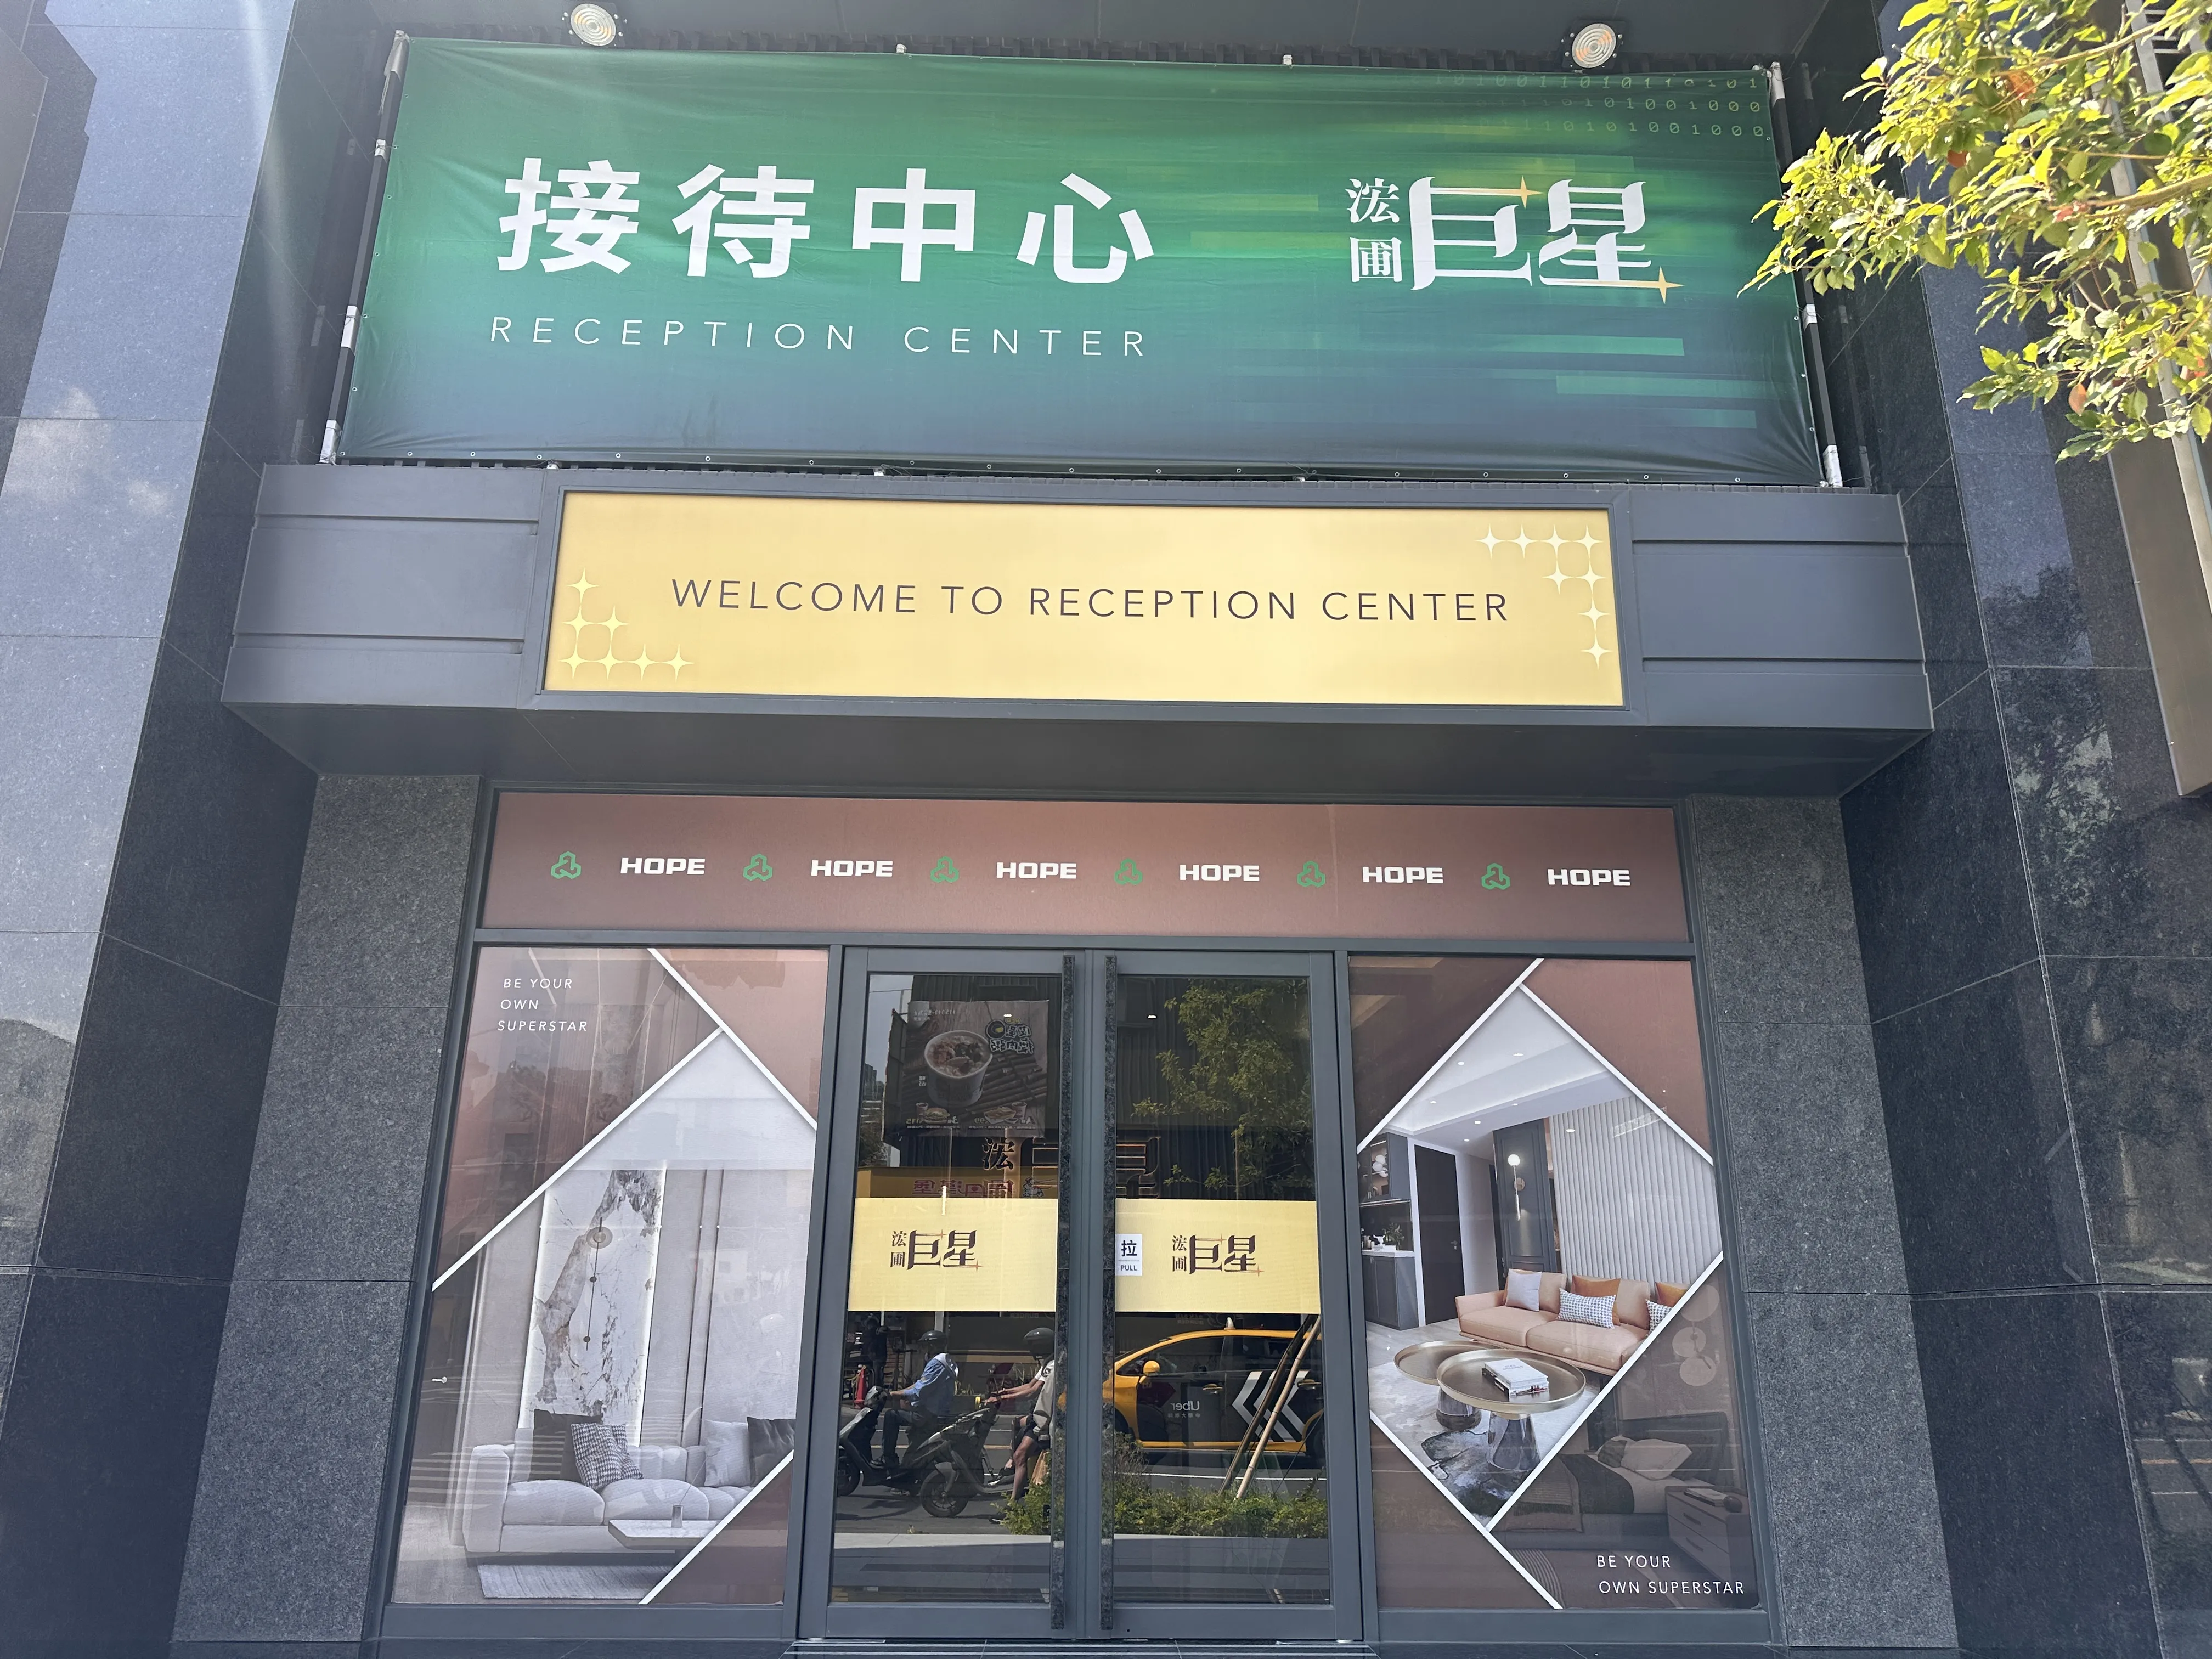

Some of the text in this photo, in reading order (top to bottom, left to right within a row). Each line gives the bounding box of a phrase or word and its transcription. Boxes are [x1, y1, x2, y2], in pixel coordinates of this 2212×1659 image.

[498, 157, 1154, 284] 接待中心
[1409, 176, 1673, 291] 巨星
[491, 317, 1143, 356] RECEPTION CENTER
[672, 579, 1508, 621] WELCOME TO RECEPTION CENTER
[621, 857, 1631, 886] HOPE HOPE HOPE HOPE HOPE HOPE
[503, 978, 572, 989] BE YOUR
[500, 1000, 539, 1009] OWN
[498, 1020, 587, 1031] SUPERSTAR
[907, 1230, 980, 1271] 巨星
[1121, 1240, 1137, 1257] 拉
[1189, 1234, 1261, 1274] 巨星
[1597, 1555, 1671, 1568] BE YOUR
[1599, 1581, 1744, 1594] OWN SUPERSTAR
